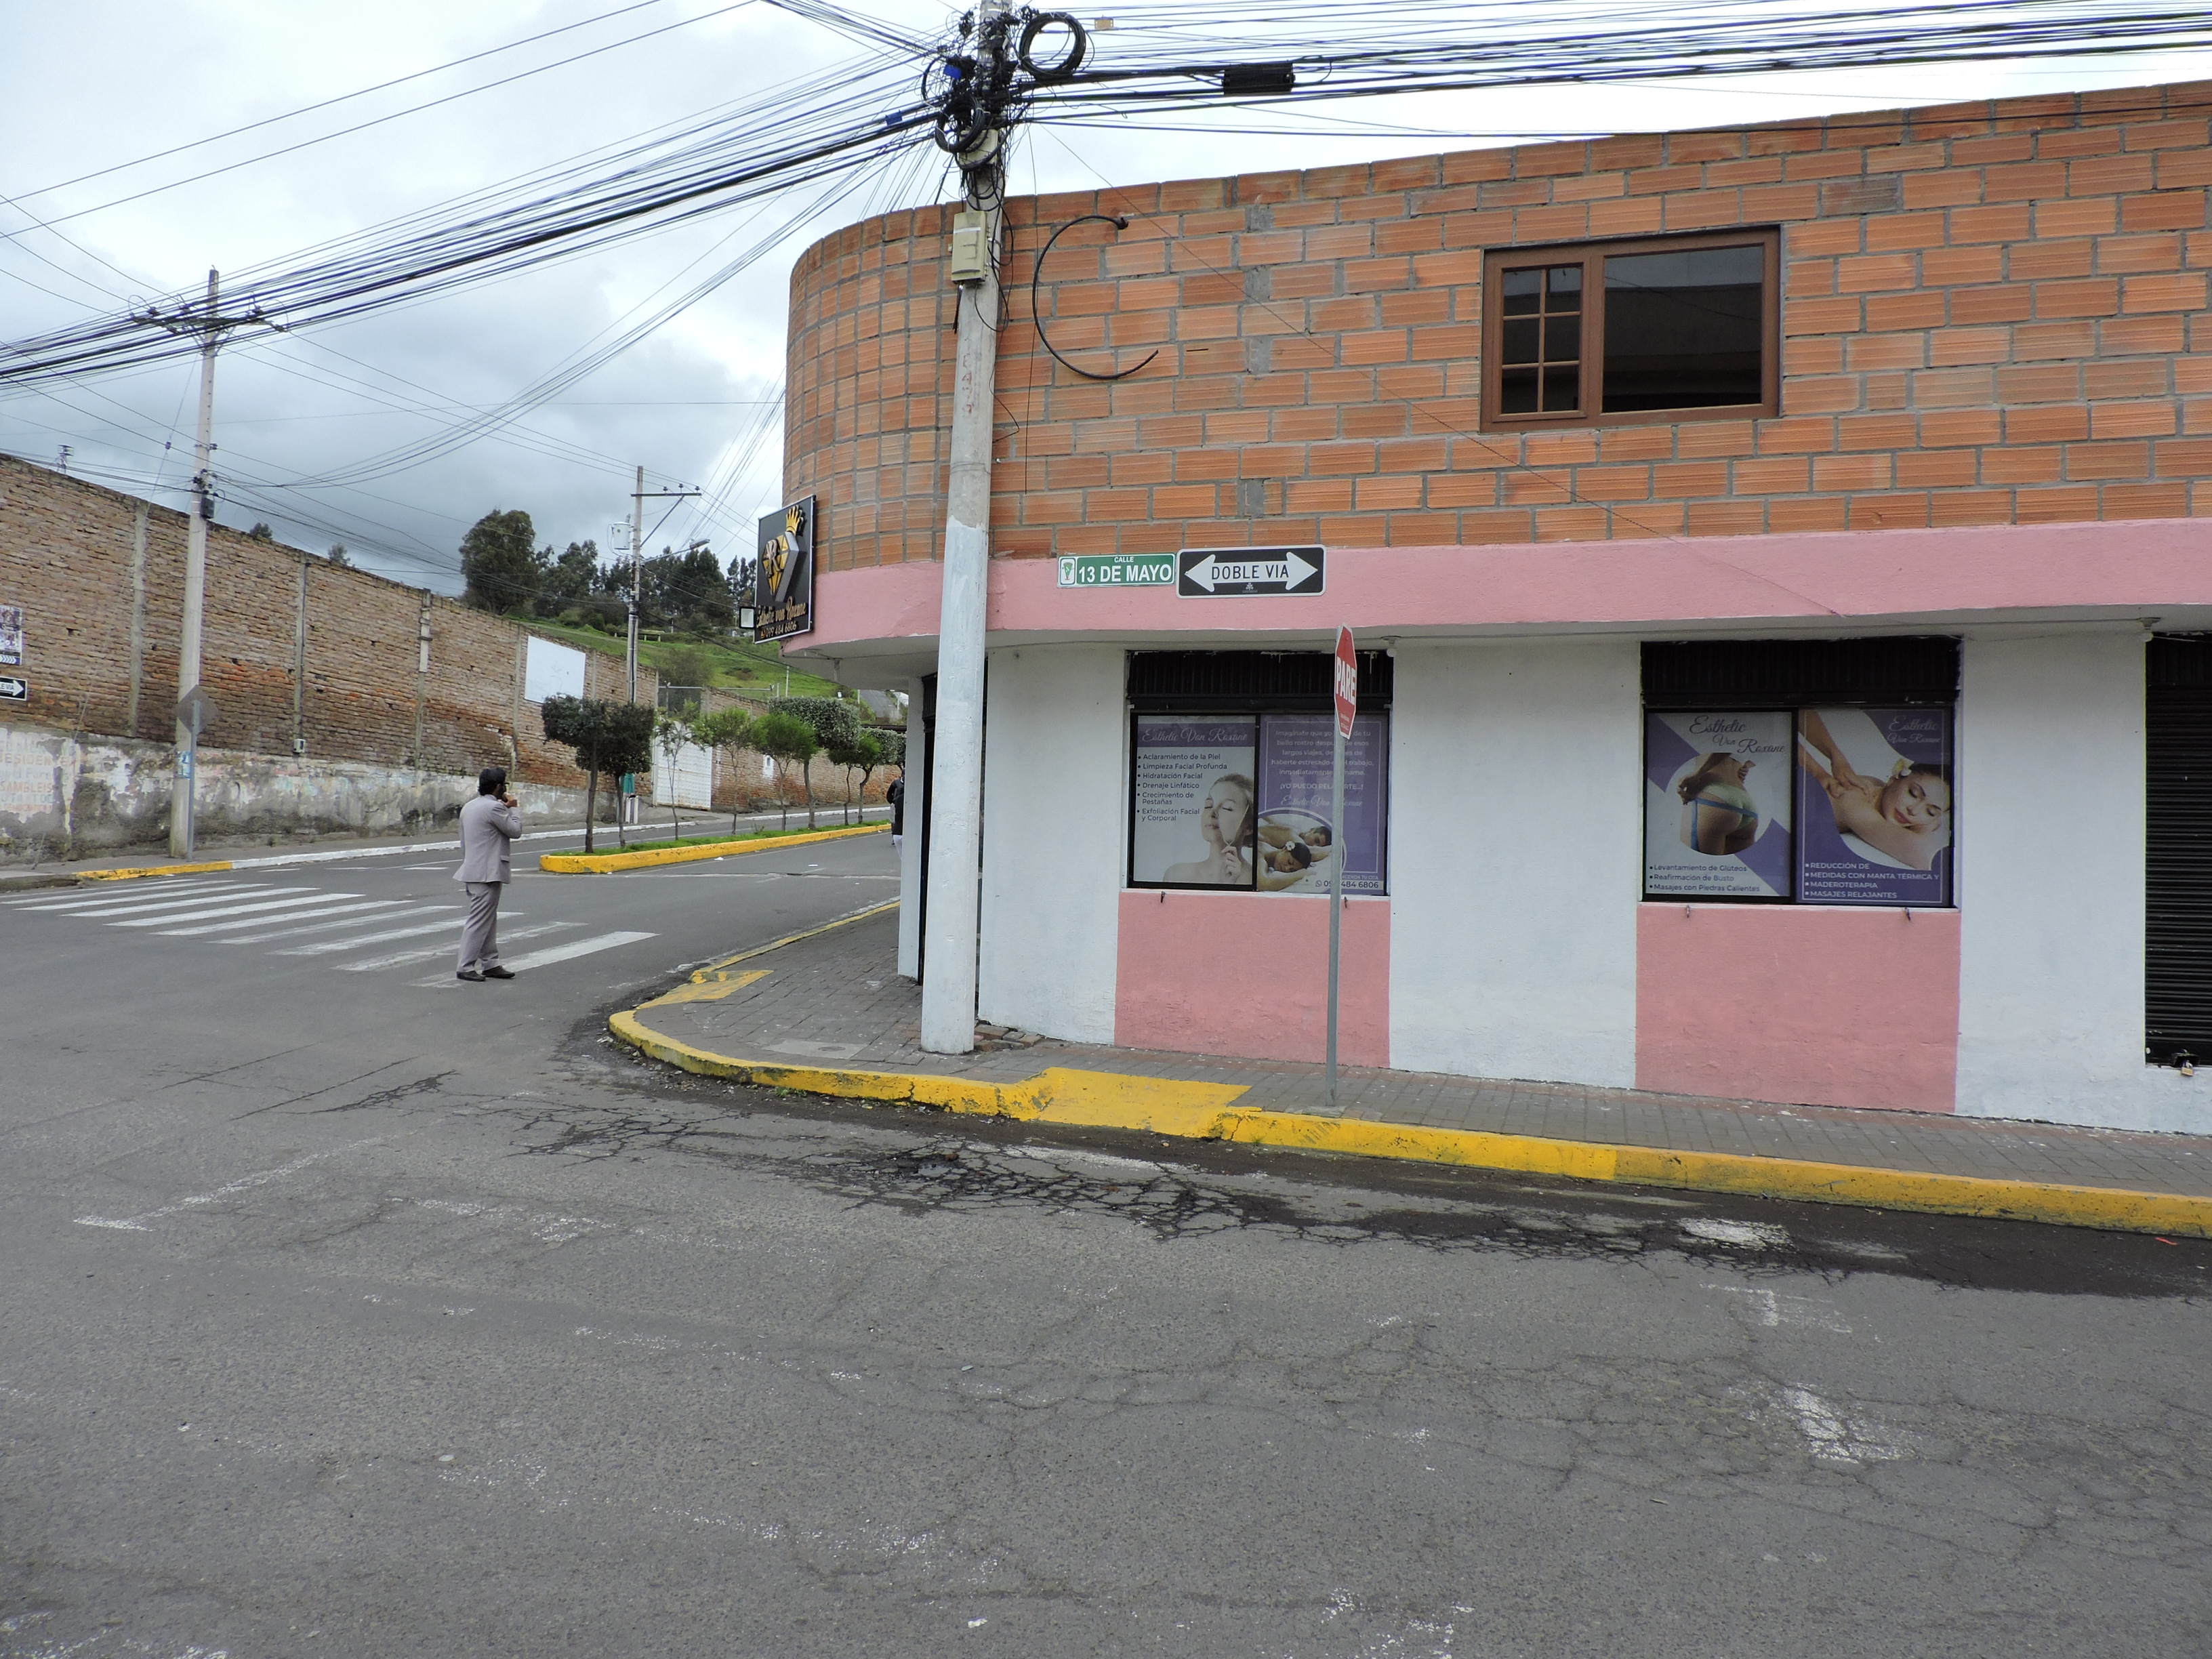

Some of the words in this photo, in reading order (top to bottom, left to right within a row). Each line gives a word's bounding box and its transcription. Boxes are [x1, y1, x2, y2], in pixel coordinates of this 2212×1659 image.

[1078, 567, 1096, 583] 13
[1101, 566, 1122, 582] DE
[1126, 564, 1172, 581] MAYO
[1211, 565, 1260, 580] DOBLE
[1265, 563, 1290, 579] VIA
[785, 621, 797, 632] 6806
[1336, 656, 1356, 706] PARE
[1689, 715, 1747, 734] Esthetic
[1737, 738, 1786, 754] Roxane
[1143, 782, 1169, 790] Drenaje
[1810, 861, 1857, 869] REDUCCIÓN
[1654, 884, 1682, 892] Masajes
[1810, 881, 1878, 889] MADEROTERAPIA
[1847, 891, 1898, 899] RELAJANTES
